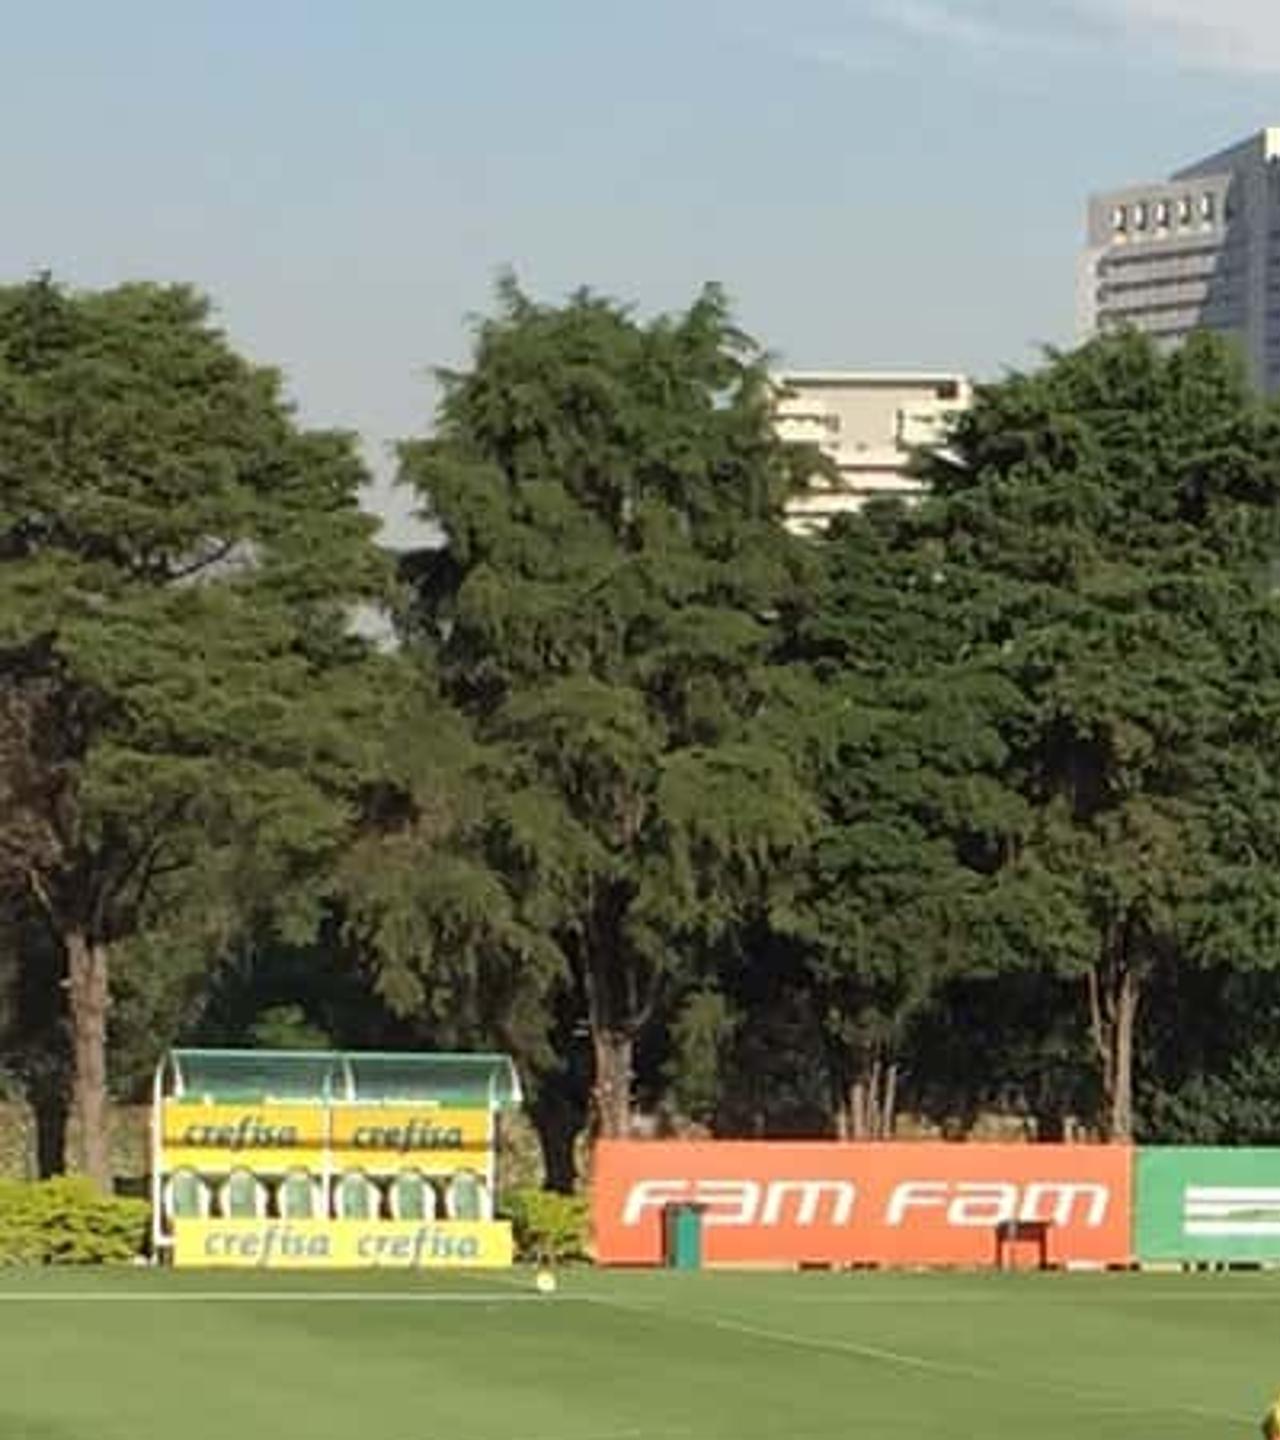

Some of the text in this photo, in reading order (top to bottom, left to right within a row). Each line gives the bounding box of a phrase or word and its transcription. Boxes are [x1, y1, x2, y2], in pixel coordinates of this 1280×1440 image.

[184, 1116, 298, 1151] crefisa
[353, 1118, 463, 1153] crefisa
[204, 1224, 479, 1267] crefisa crefisa
